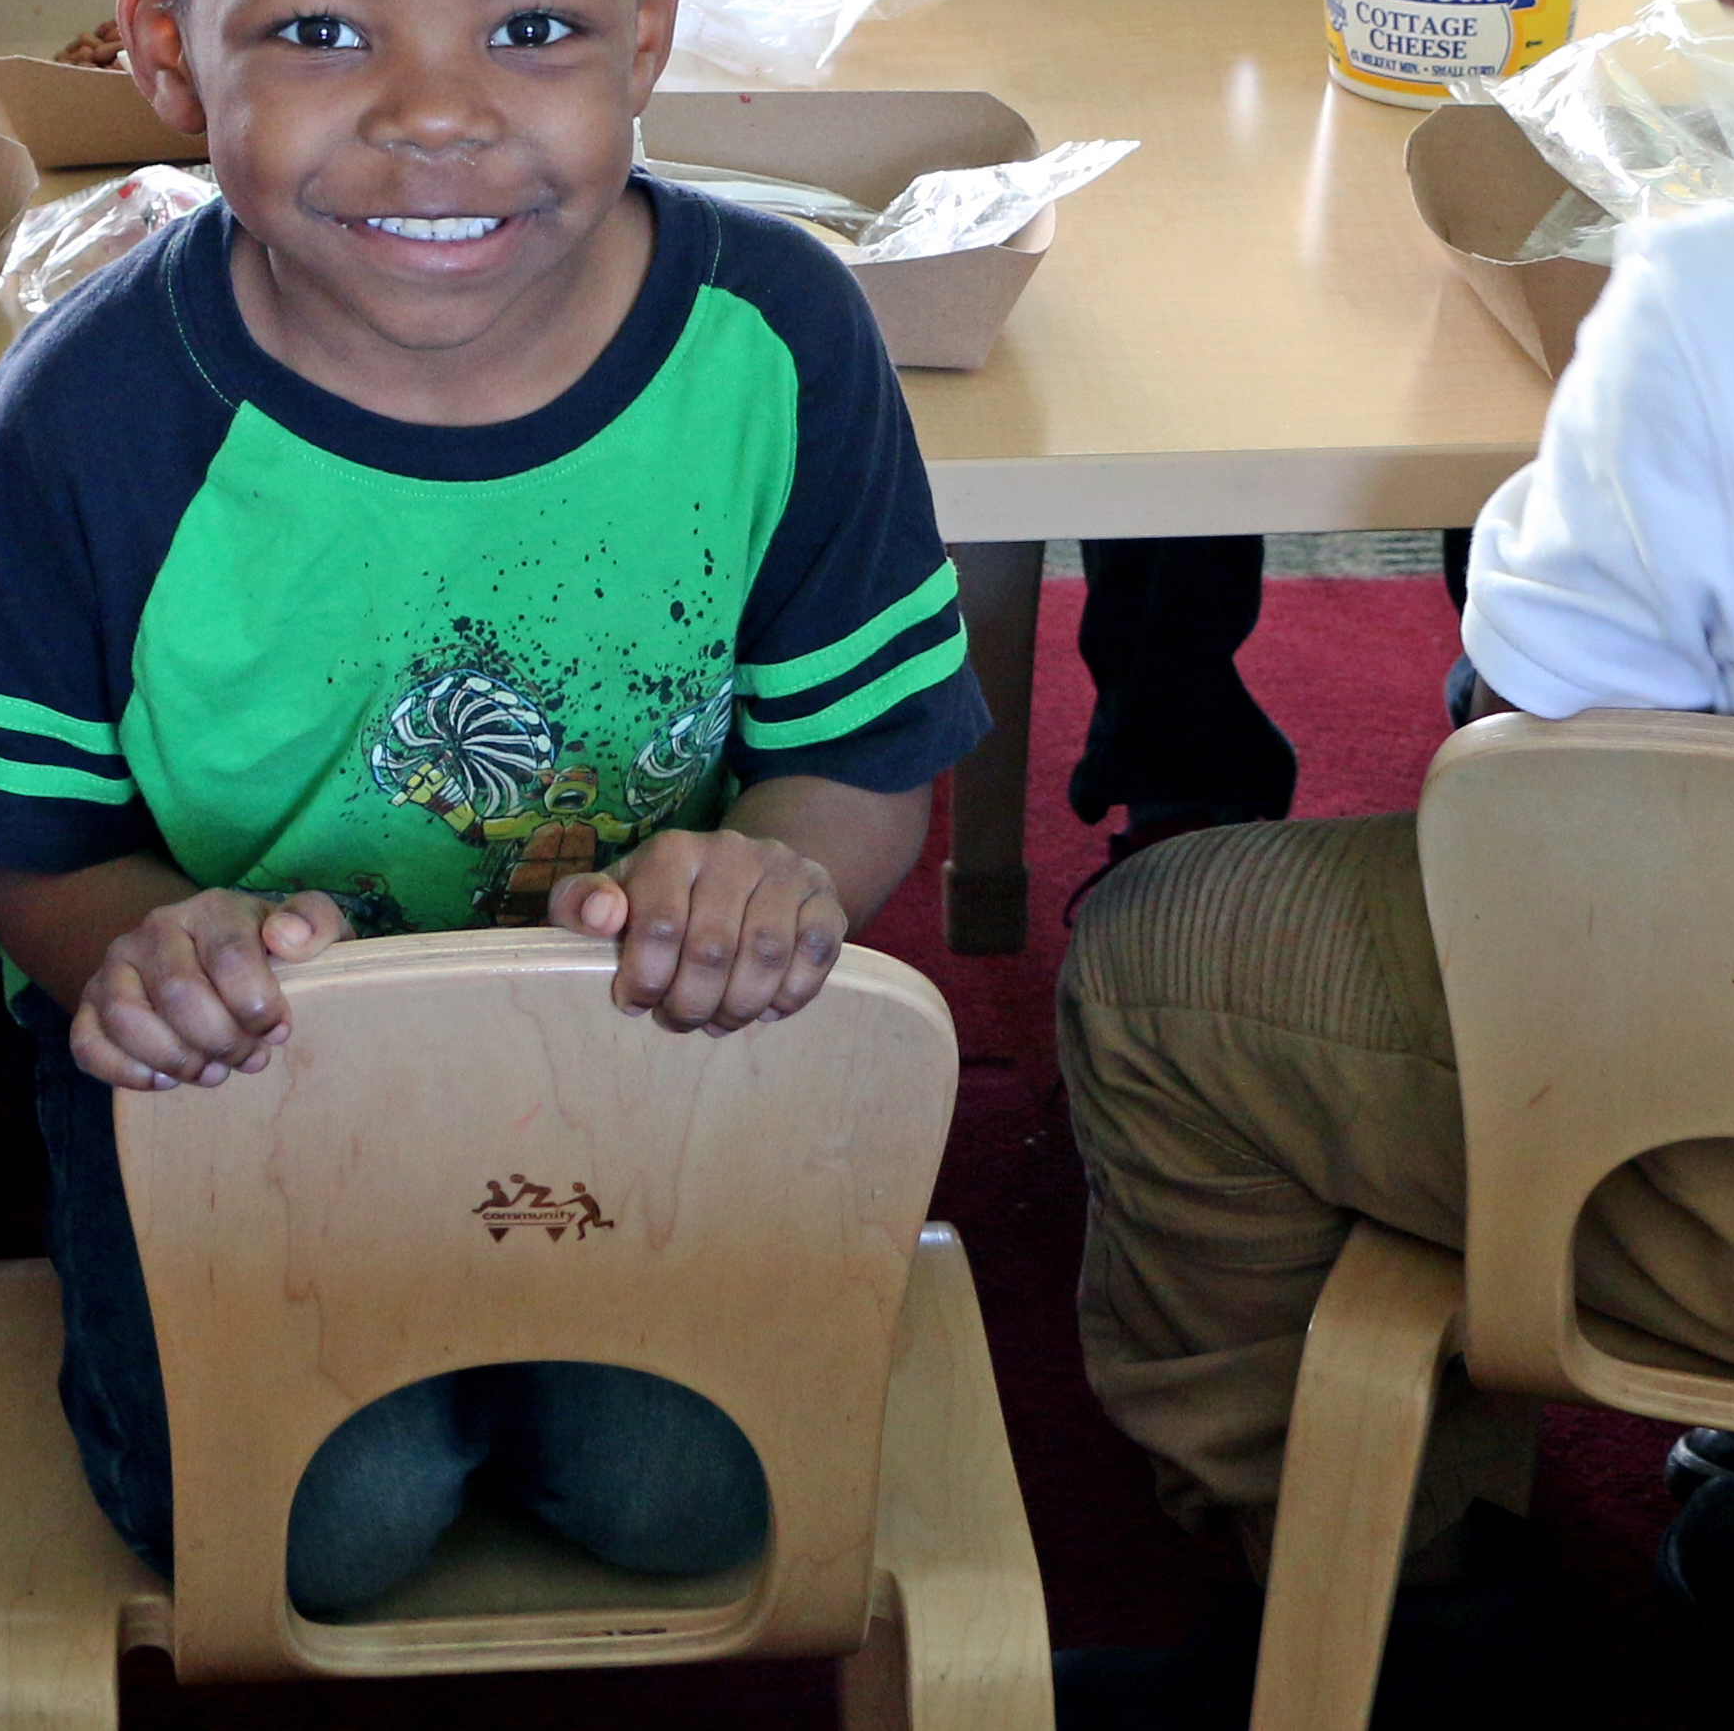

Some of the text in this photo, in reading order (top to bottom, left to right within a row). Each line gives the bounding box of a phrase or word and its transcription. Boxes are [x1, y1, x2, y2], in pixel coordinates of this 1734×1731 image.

[1354, 1, 1479, 38] COTTAGE
[1368, 28, 1468, 61] CHEESE
[482, 1208, 577, 1224] community
